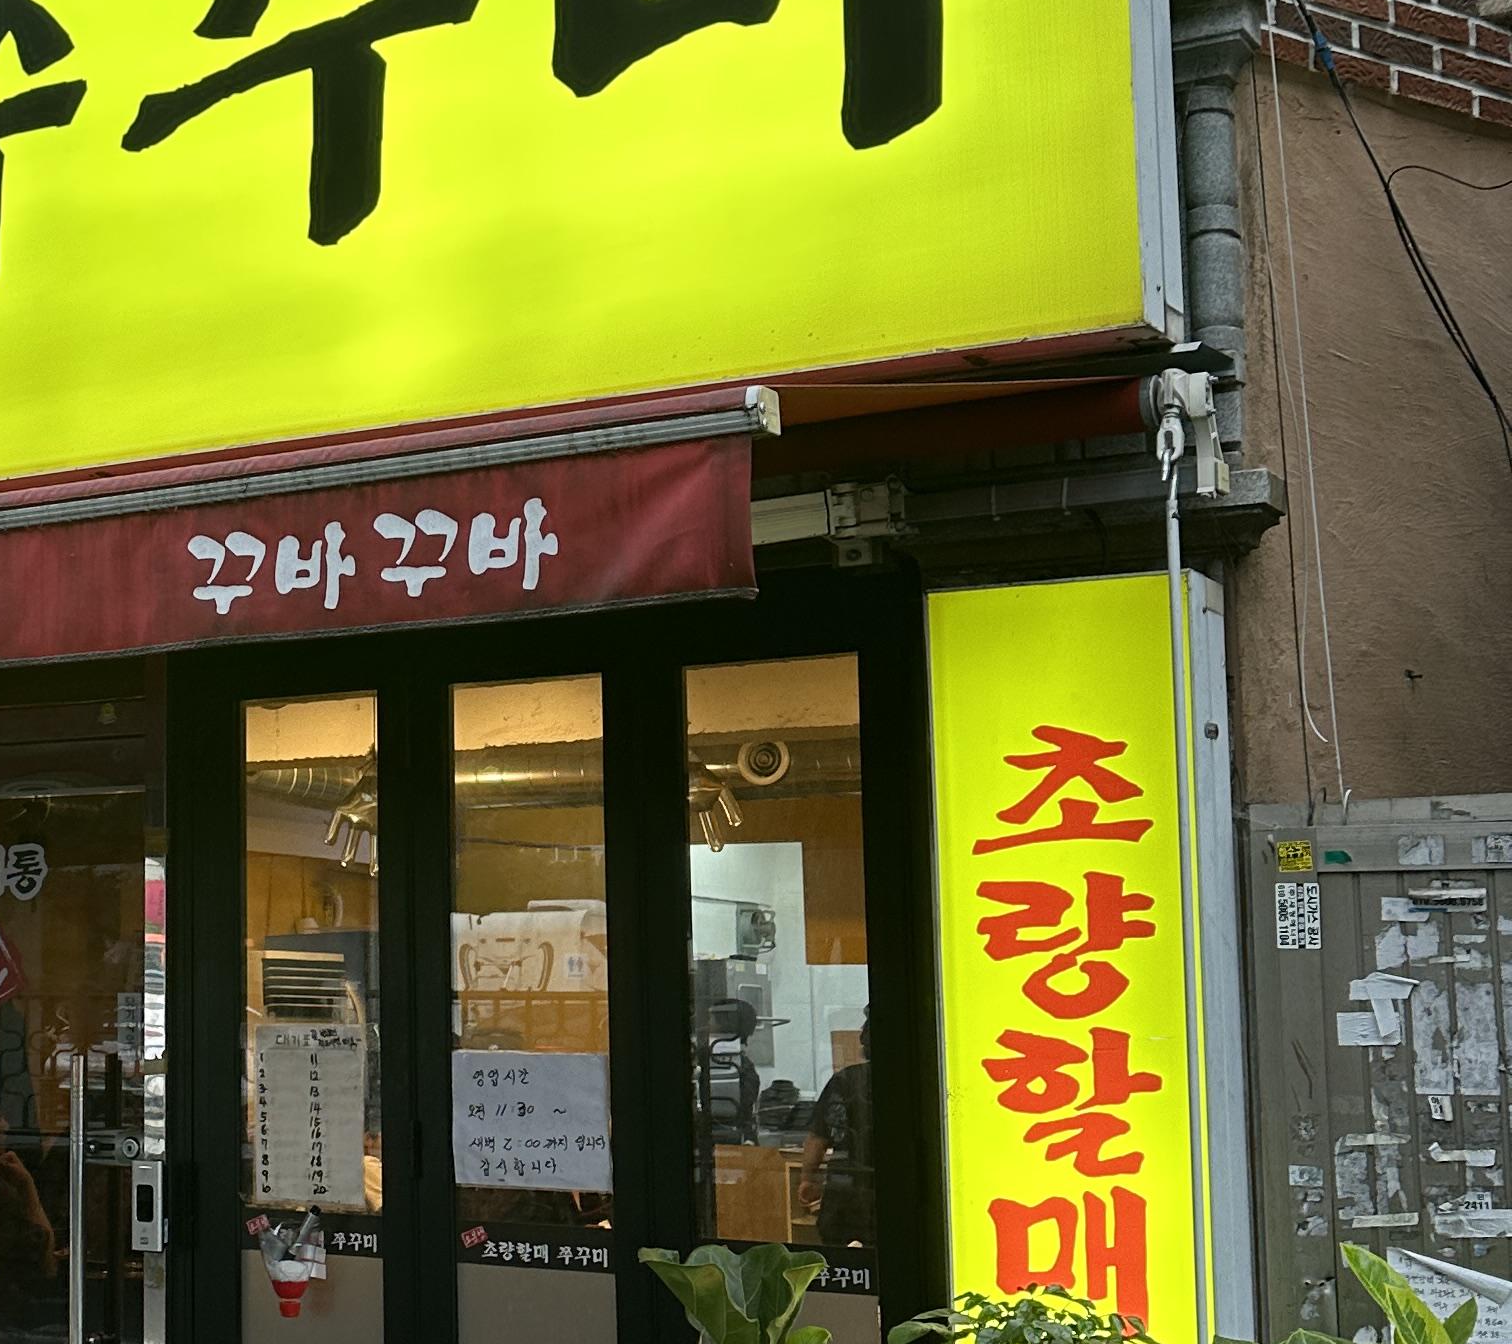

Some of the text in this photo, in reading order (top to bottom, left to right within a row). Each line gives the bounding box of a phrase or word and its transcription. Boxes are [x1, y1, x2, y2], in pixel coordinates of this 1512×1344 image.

[971, 723, 1163, 1338] 초량할매
[472, 1067, 530, 1087] 영업시간
[330, 1231, 379, 1254] 쭈꾸미
[481, 1240, 609, 1269] 초량할매 쭈꾸미
